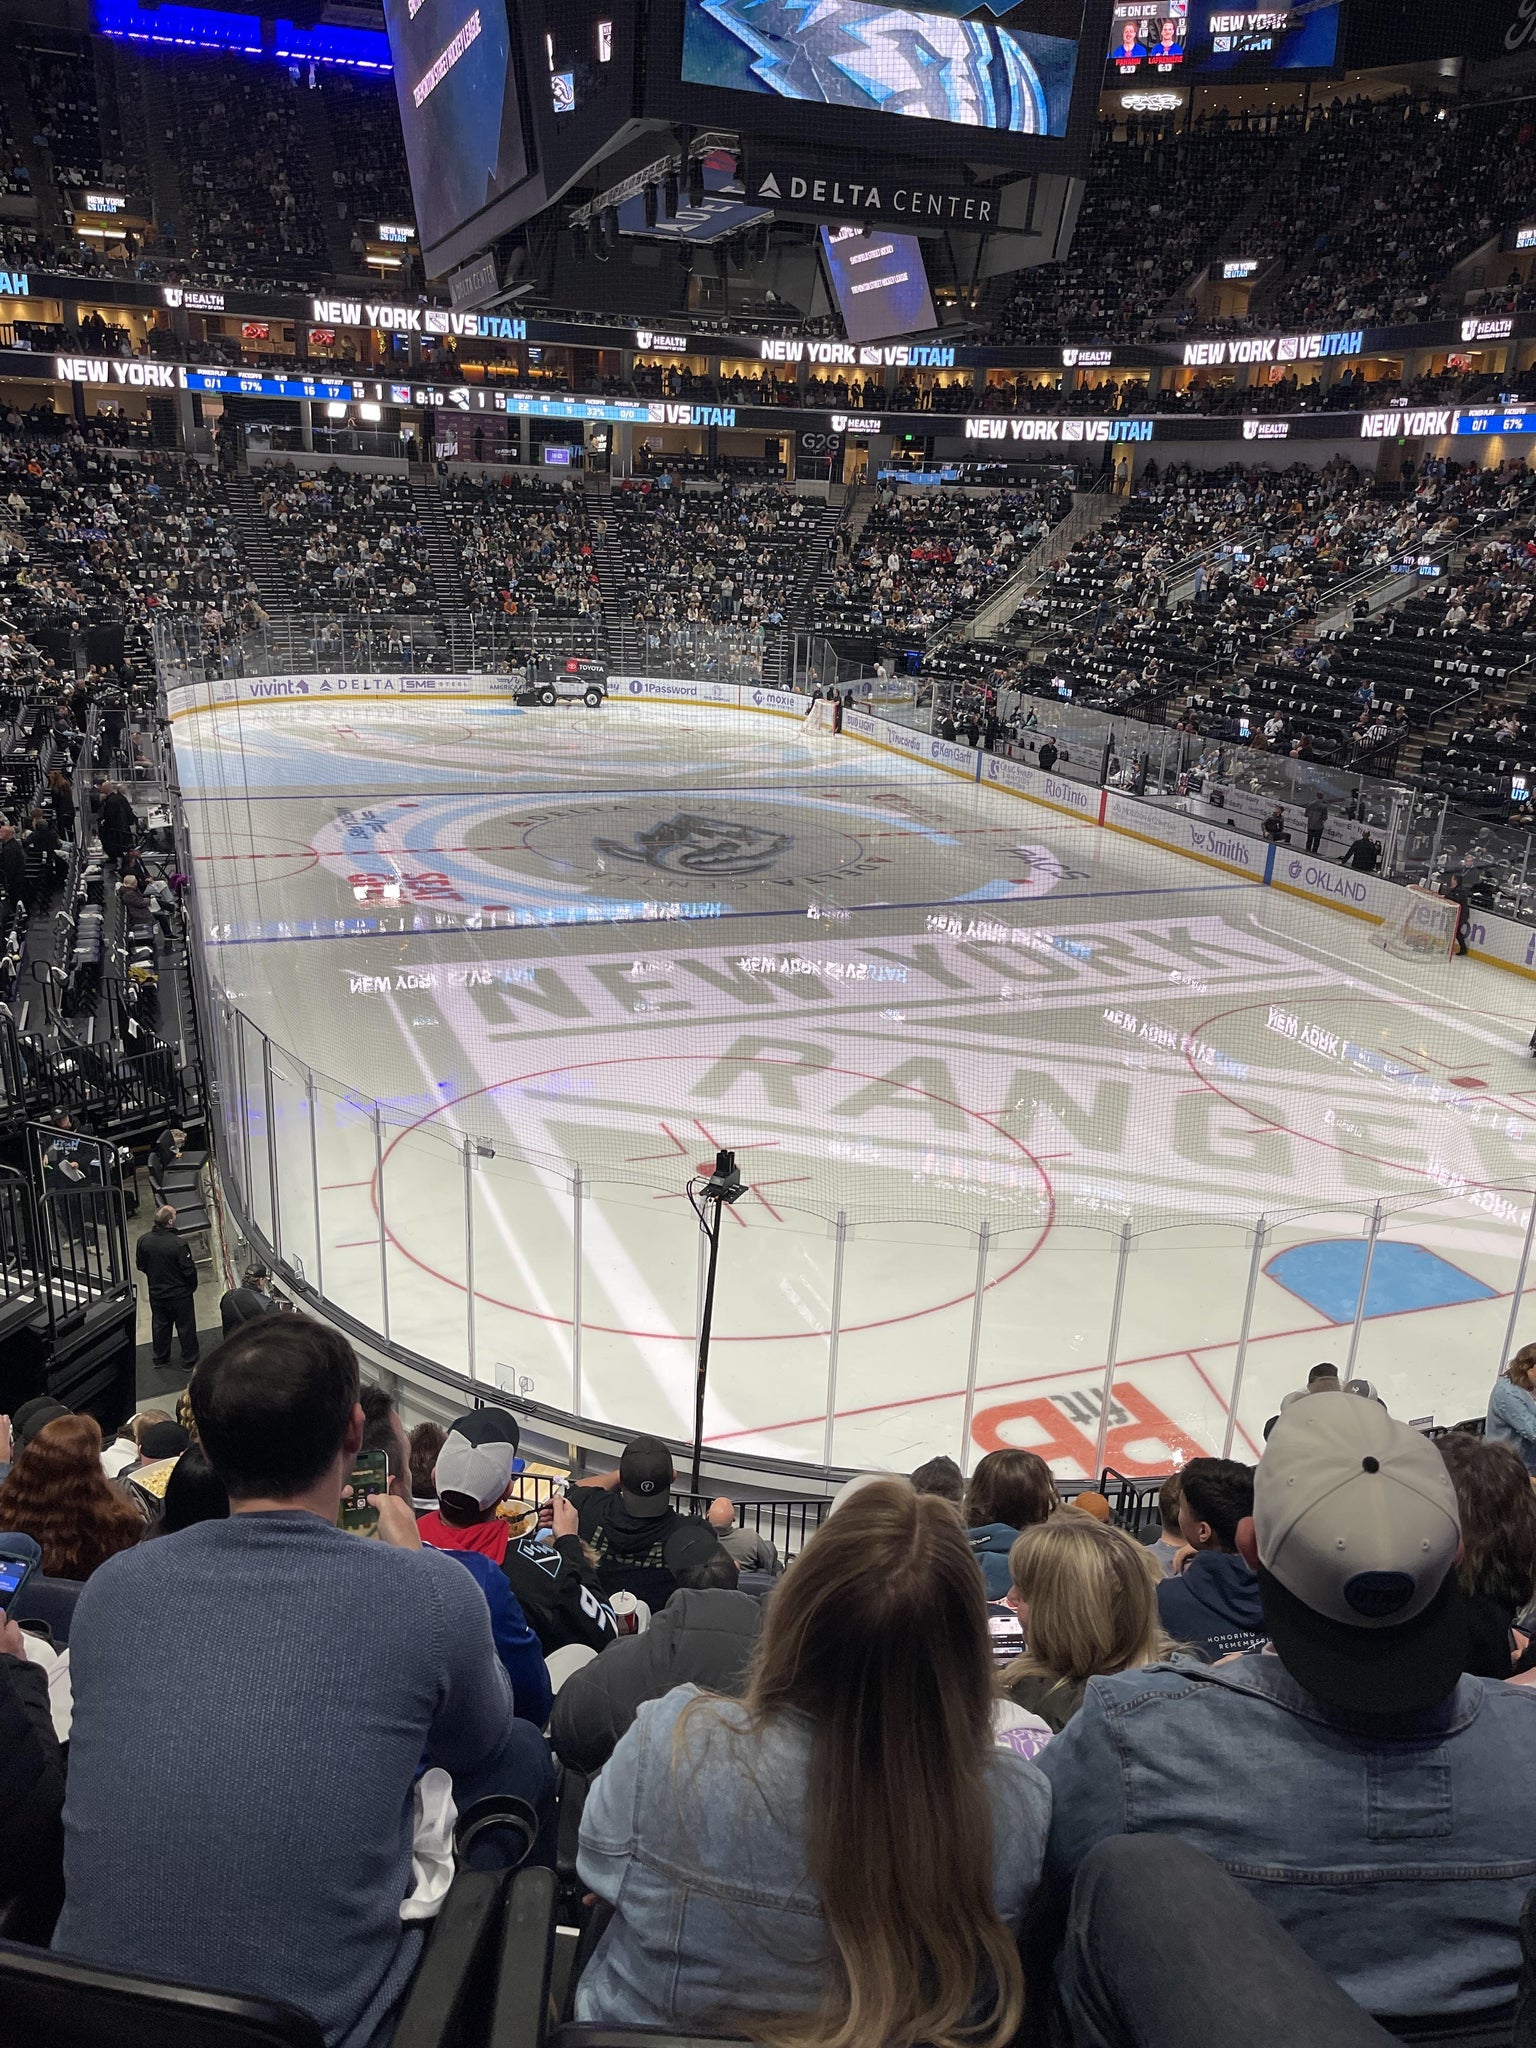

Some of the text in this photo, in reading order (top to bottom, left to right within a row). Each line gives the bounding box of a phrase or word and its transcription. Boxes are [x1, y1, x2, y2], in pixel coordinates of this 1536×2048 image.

[1128, 5, 1157, 16] ON ICE
[1210, 13, 1288, 33] NEW YORK
[1138, 29, 1149, 38] LW
[1176, 27, 1187, 36] LW
[1120, 65, 1136, 74] 6:33
[1158, 64, 1172, 72] 6:13
[87, 195, 125, 208] NEW YORK
[790, 176, 991, 222] DELTA CENTER
[97, 204, 116, 213] UTAH
[380, 225, 415, 237] NEW YORK
[1517, 229, 1532, 240] NEW
[389, 234, 407, 242] UTAH
[1225, 262, 1257, 271] NEW YORK
[1231, 270, 1247, 278] UTAH
[185, 292, 225, 306] HEALTH
[314, 300, 527, 340] NEW YORK VS UTAH
[1478, 320, 1513, 334] HEALTH
[653, 335, 687, 348] HEALTH
[761, 340, 955, 367] NEW YORK VS UTAH
[1183, 331, 1364, 366] NEW YORK VS UTAH
[1078, 351, 1112, 362] HEALTH
[57, 358, 175, 388] NEW YORK
[204, 378, 221, 389] 0/1
[241, 381, 263, 392] 67%
[280, 384, 285, 394] 1
[304, 386, 316, 396] 16
[328, 387, 340, 398] 17
[353, 388, 365, 398] 12
[375, 384, 383, 400] 1
[416, 391, 444, 406] 8:10
[478, 392, 485, 408] 1
[495, 399, 506, 410] 13
[518, 402, 530, 412] 22
[586, 407, 605, 417] 33%
[620, 409, 635, 419] 0/0
[666, 404, 736, 427] VS UTAH
[847, 418, 881, 430] HEALTH
[965, 419, 1154, 441] NEW YORK VS UTAH
[1257, 423, 1289, 435] HEALTH
[1361, 411, 1450, 438] NEW YORK
[1472, 419, 1487, 431] 0/1
[1503, 418, 1523, 430] 67%
[802, 432, 840, 451] G2G
[579, 664, 605, 673] TOYOTA
[250, 679, 295, 697] vivint
[338, 678, 394, 690] DELTA
[406, 680, 436, 689] SME
[644, 683, 698, 697] 1Password
[766, 693, 795, 707] moxie
[847, 715, 875, 733] BUD LIGHT
[892, 730, 921, 751] Trucordia
[939, 742, 972, 765] Ken Garff
[528, 804, 632, 822] DELTA
[1205, 830, 1250, 865] Smith's
[1306, 867, 1367, 902] OKLAND
[466, 922, 1290, 1026] NEW YORK
[1048, 1387, 1130, 1427] fit
[1207, 1631, 1256, 1643] HONORING
